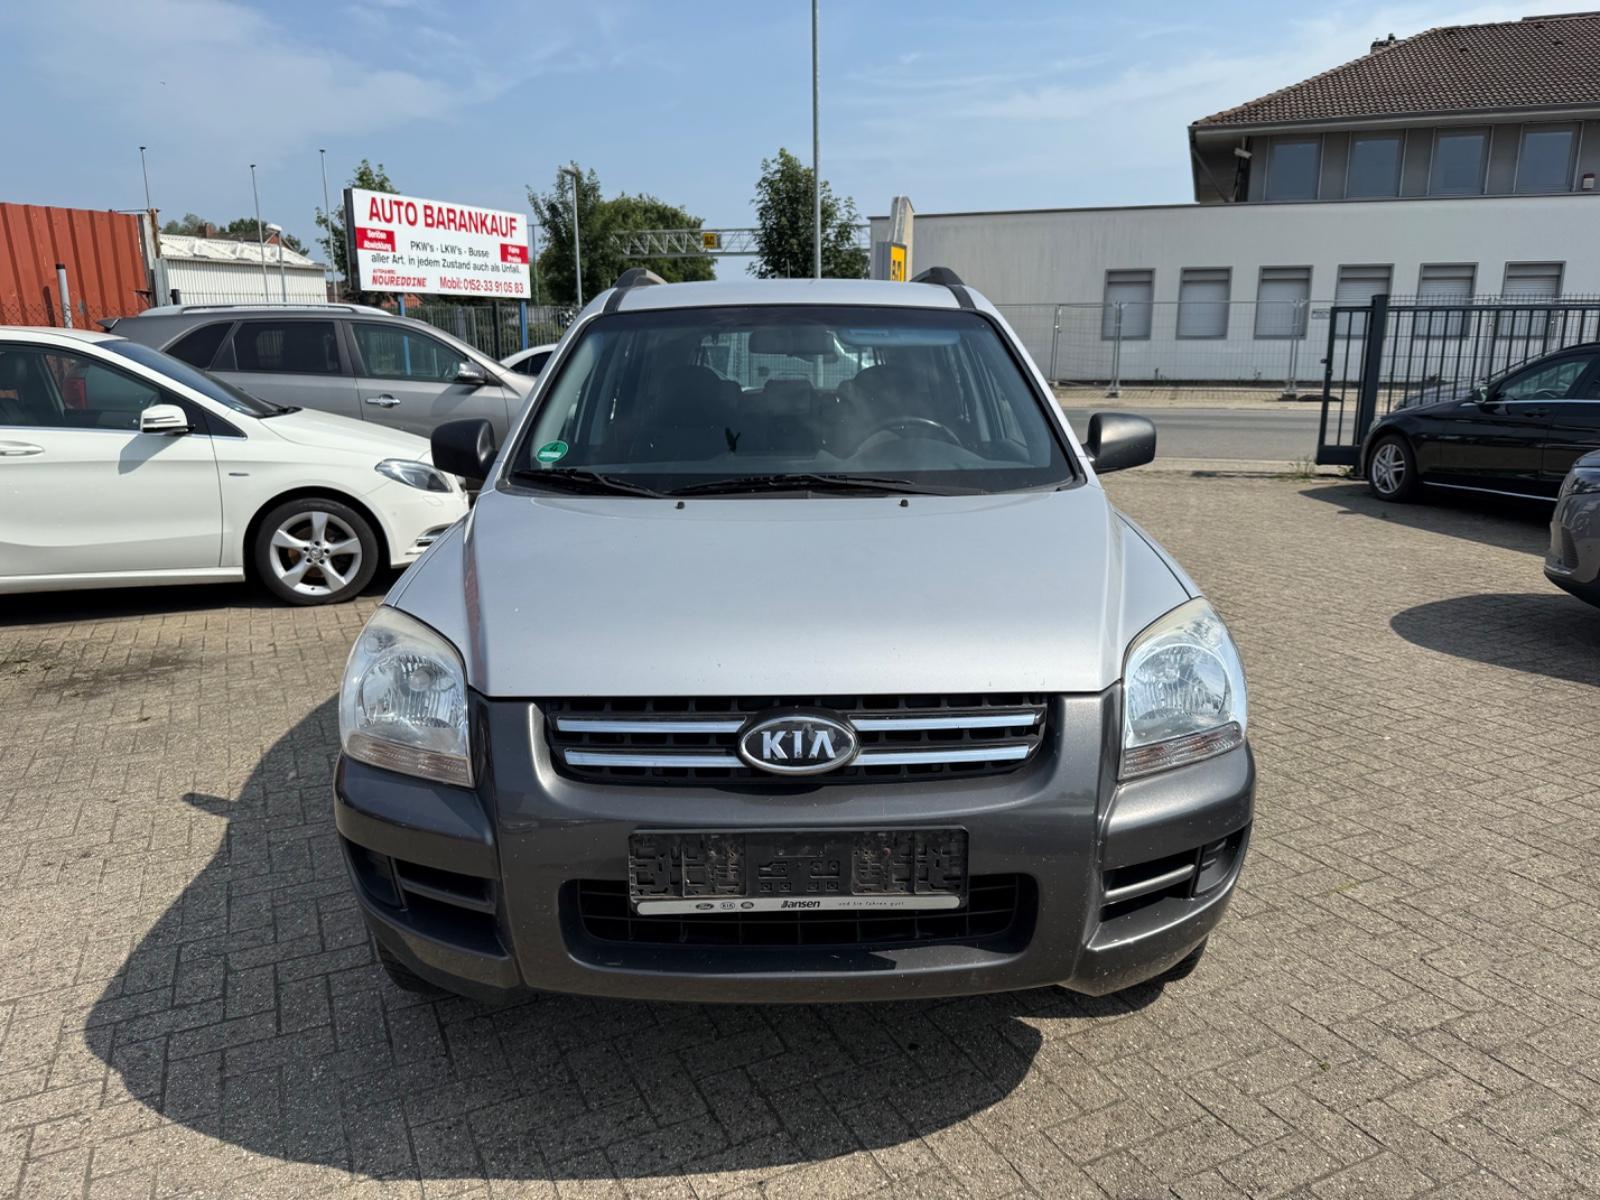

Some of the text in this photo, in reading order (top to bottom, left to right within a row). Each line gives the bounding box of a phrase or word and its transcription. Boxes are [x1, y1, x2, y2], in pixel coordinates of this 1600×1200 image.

[369, 197, 517, 238] AUTO BARANKAUF
[410, 241, 489, 258] PKW's LKW's Busse
[371, 253, 389, 263] aller
[408, 256, 415, 264] in
[417, 257, 440, 268] jedem
[442, 259, 471, 270] Zustand
[472, 262, 489, 271] auch
[490, 263, 500, 272] als
[371, 275, 427, 287] NOUREDDINE
[439, 276, 462, 289] Mobil:
[463, 278, 493, 291] 0152-33
[514, 282, 524, 293] 83
[761, 730, 836, 759] KIA
